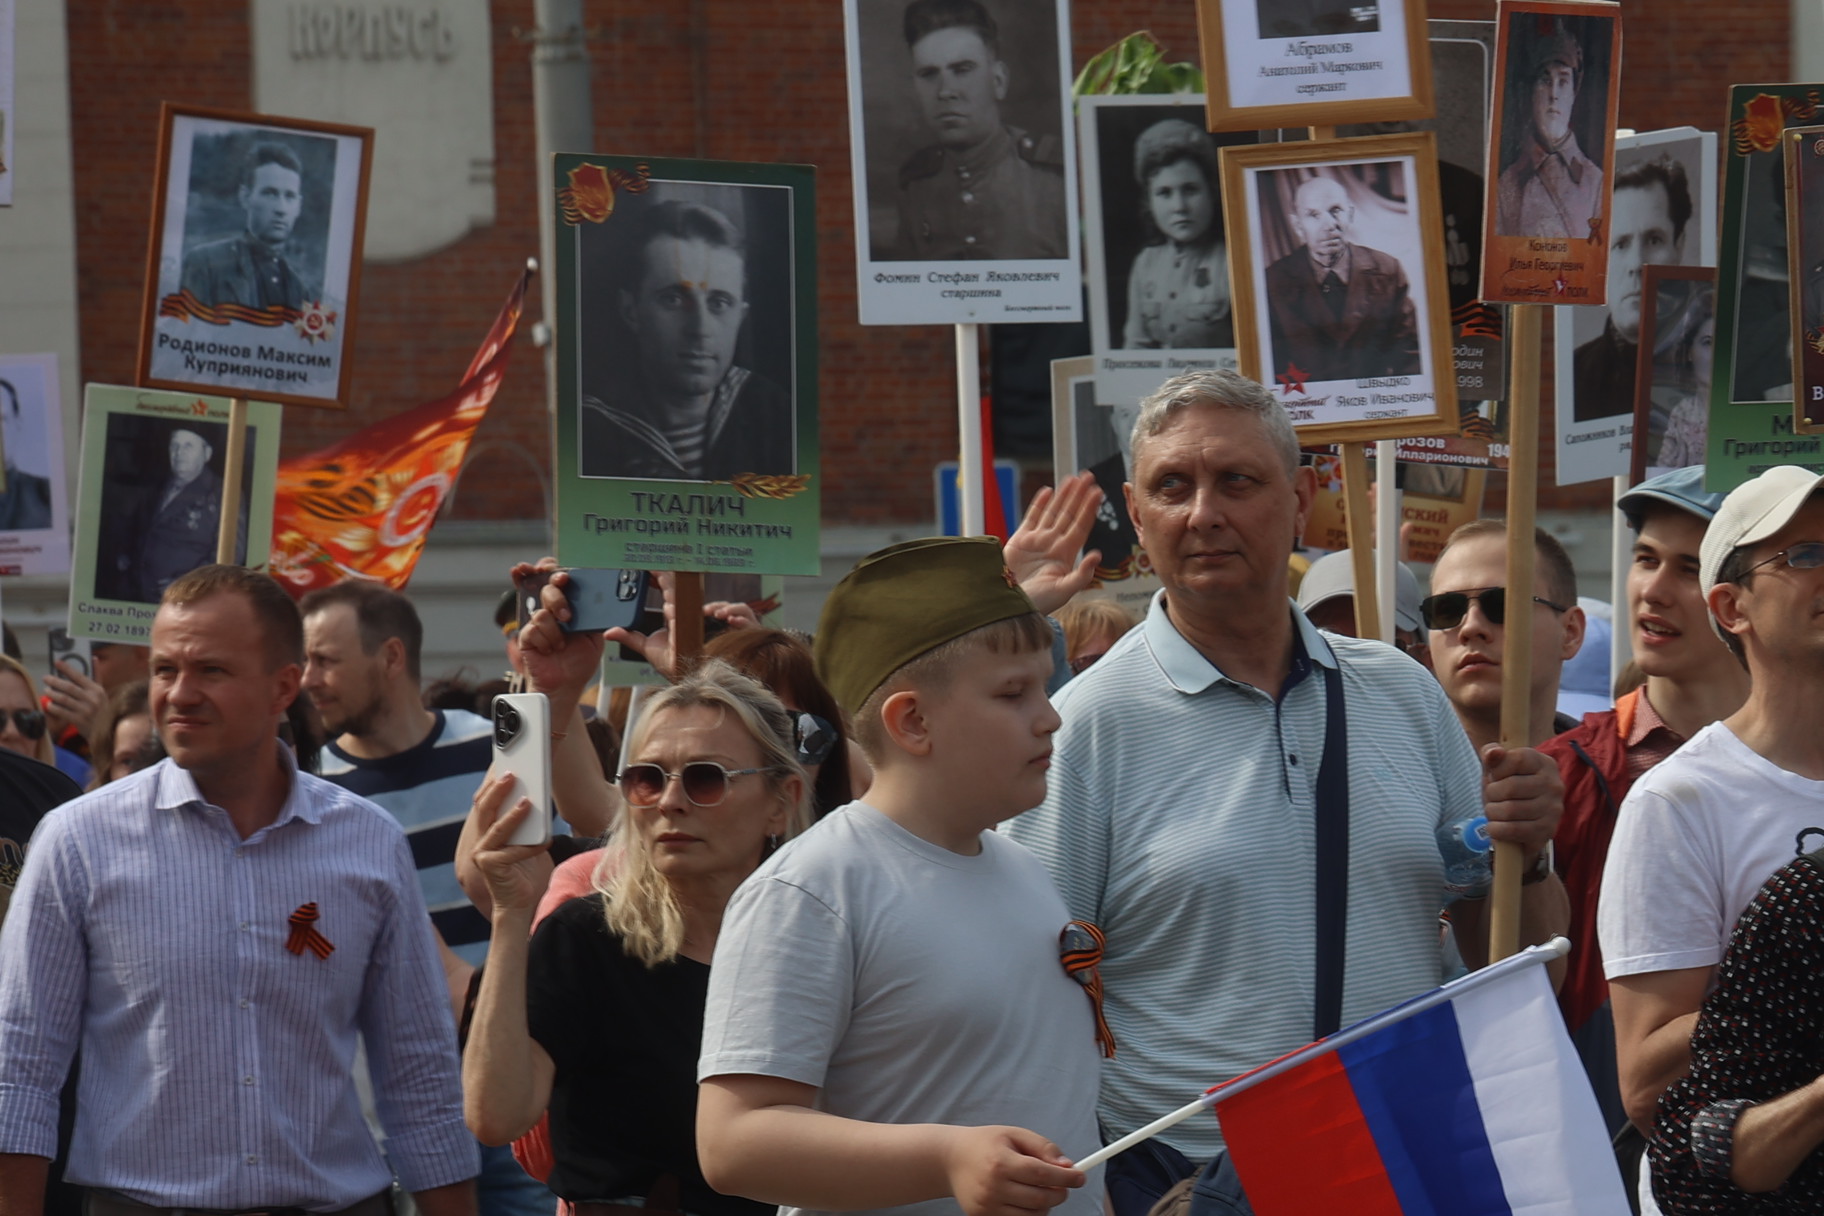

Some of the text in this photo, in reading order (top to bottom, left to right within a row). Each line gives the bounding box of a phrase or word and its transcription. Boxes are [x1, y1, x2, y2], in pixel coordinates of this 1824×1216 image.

[874, 271, 1061, 285] Фомин Стефан Яковлевич
[941, 289, 1002, 300] старшина
[158, 333, 332, 368] Родионов Максим
[184, 354, 308, 383] Куприянович
[1335, 393, 1435, 407] Яков Иванович
[1723, 436, 1821, 458] Григорий
[630, 491, 746, 518] ТКАЛИЧ
[583, 513, 793, 538] Григорий Никитич
[88, 622, 102, 632] 27
[106, 624, 121, 634] 02
